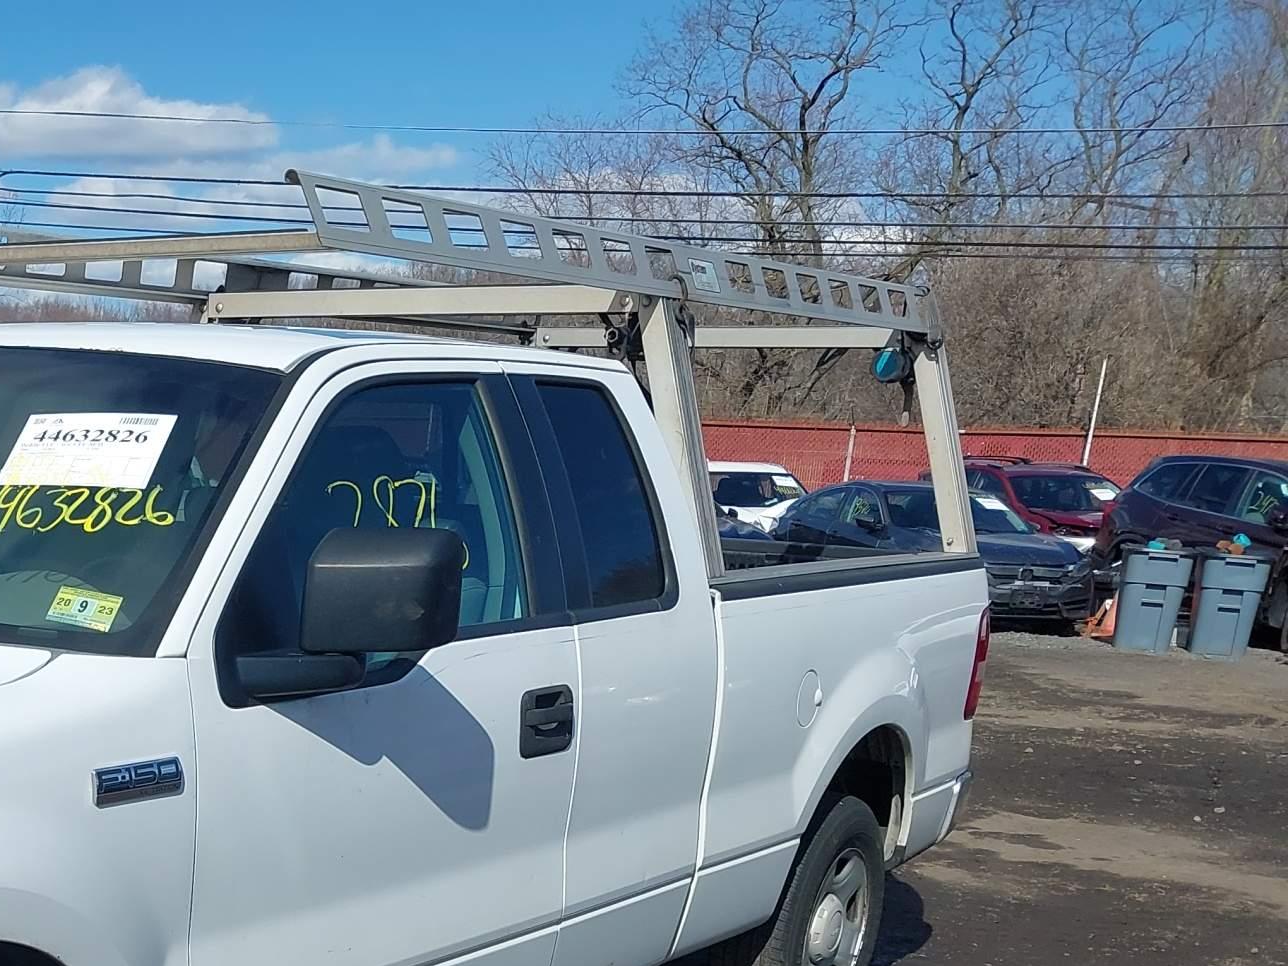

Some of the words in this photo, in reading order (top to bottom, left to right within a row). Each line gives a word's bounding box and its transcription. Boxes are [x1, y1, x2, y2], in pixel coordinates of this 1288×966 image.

[33, 428, 151, 445] 44632826
[56, 597, 72, 607] 20
[77, 600, 89, 613] 9
[97, 605, 114, 616] 23
